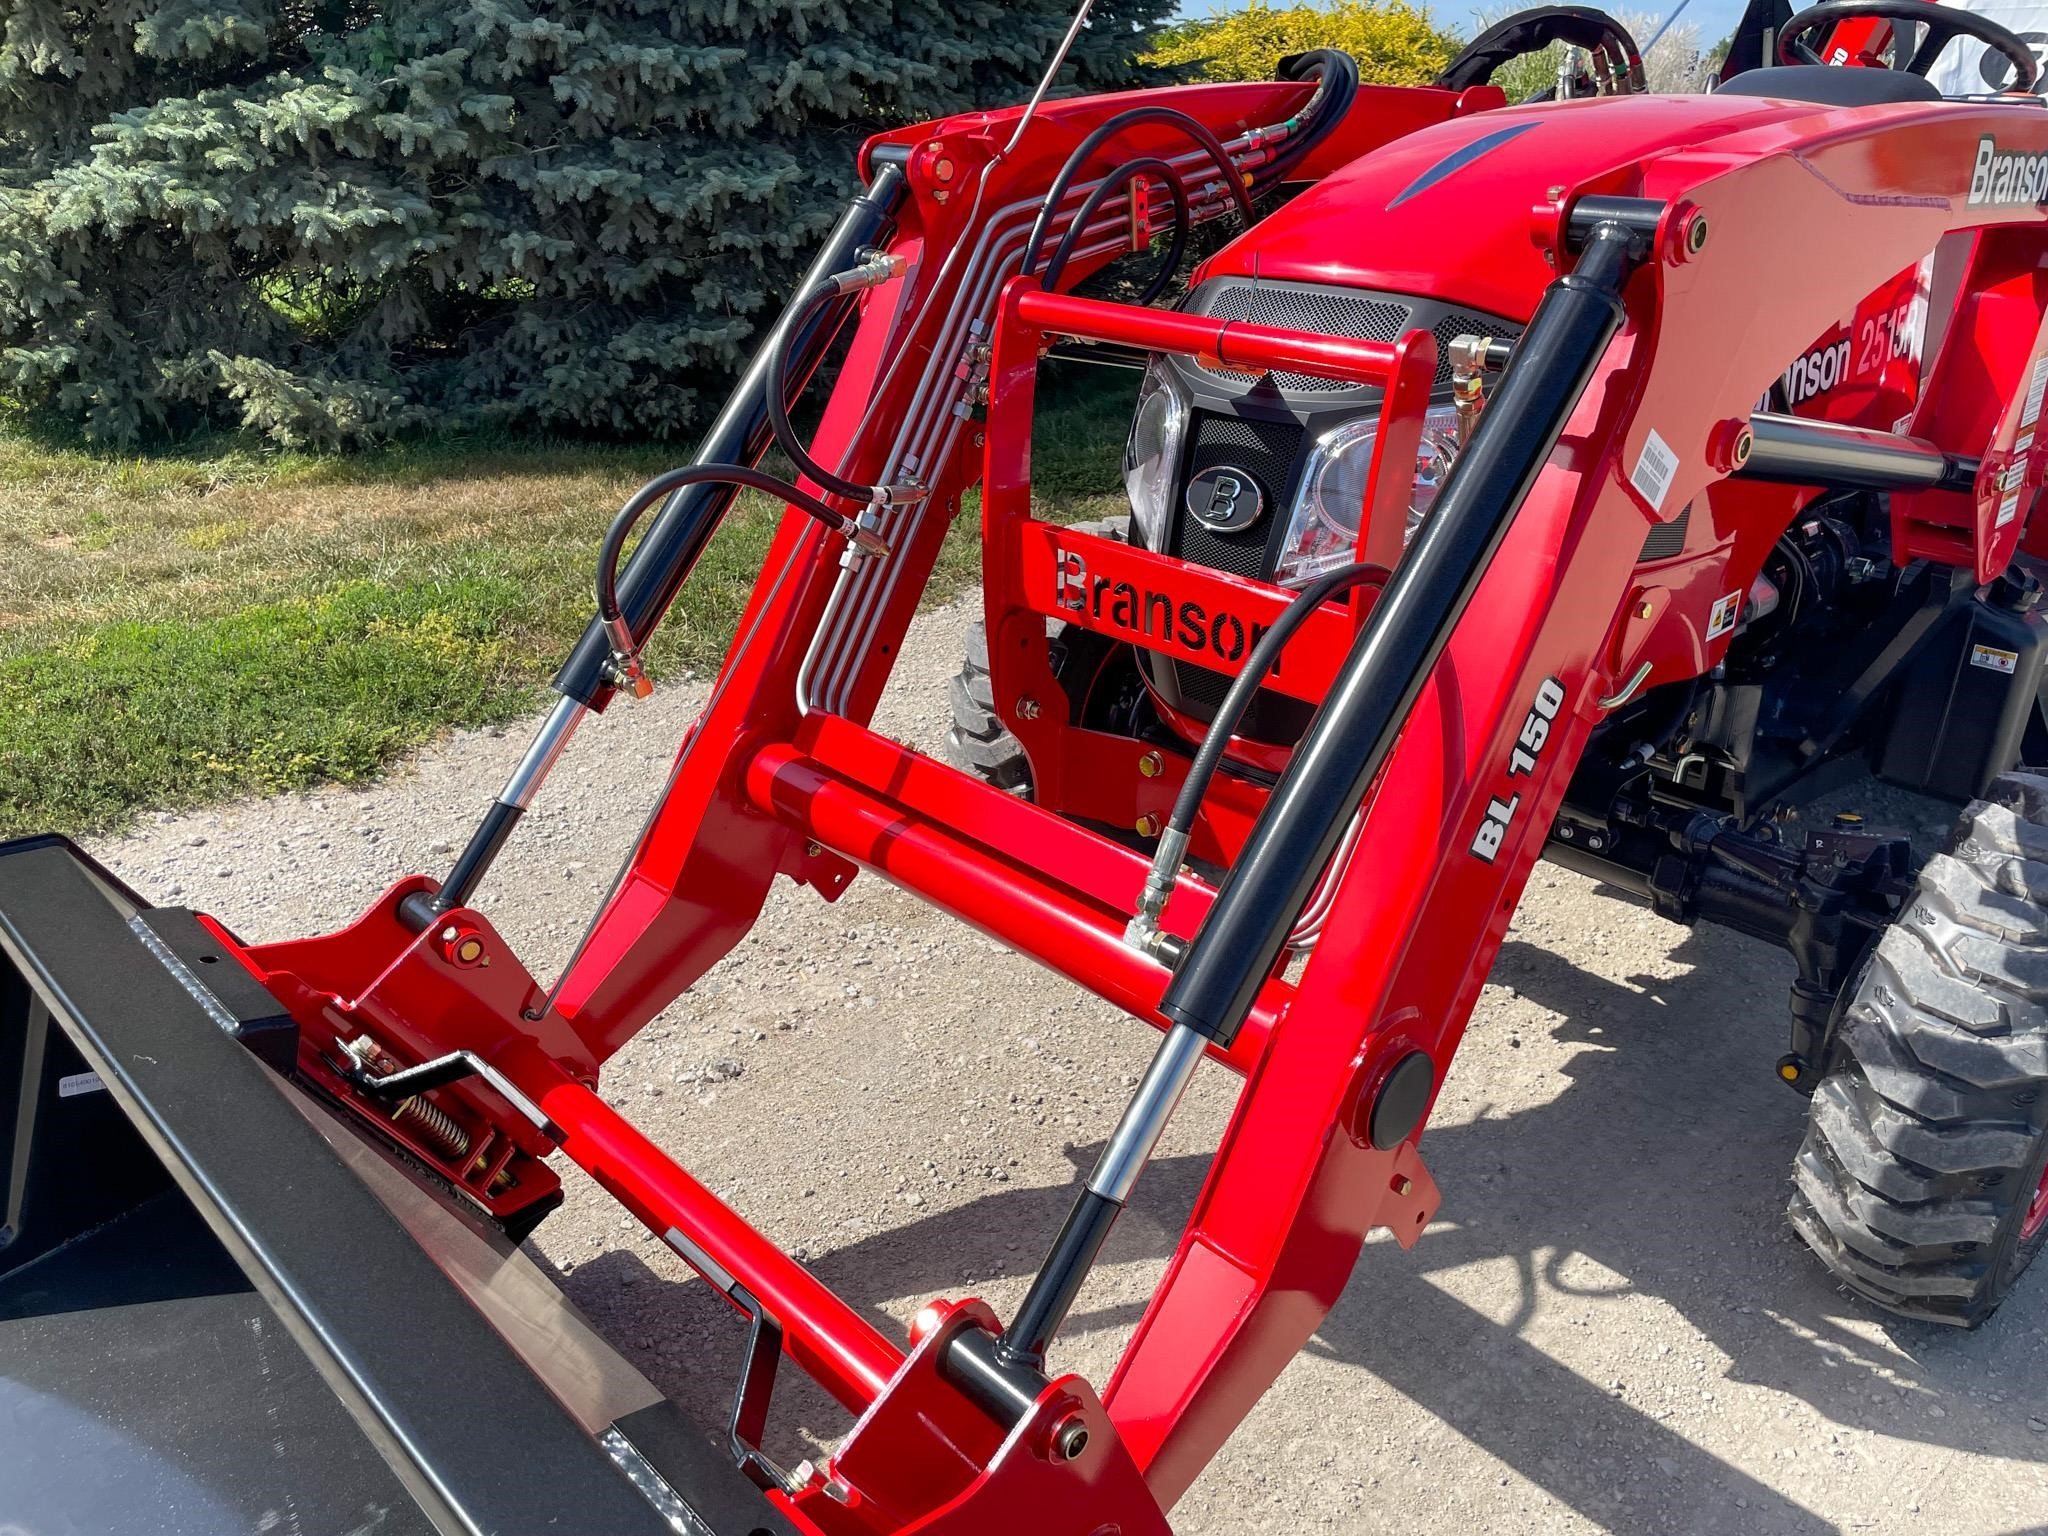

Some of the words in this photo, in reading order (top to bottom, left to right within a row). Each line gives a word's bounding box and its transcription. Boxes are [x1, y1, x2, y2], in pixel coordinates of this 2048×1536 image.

[1857, 300, 1919, 375] 2515R
[1205, 475, 1241, 521] B
[1471, 795, 1520, 862] BL
[1508, 678, 1565, 775] 150
